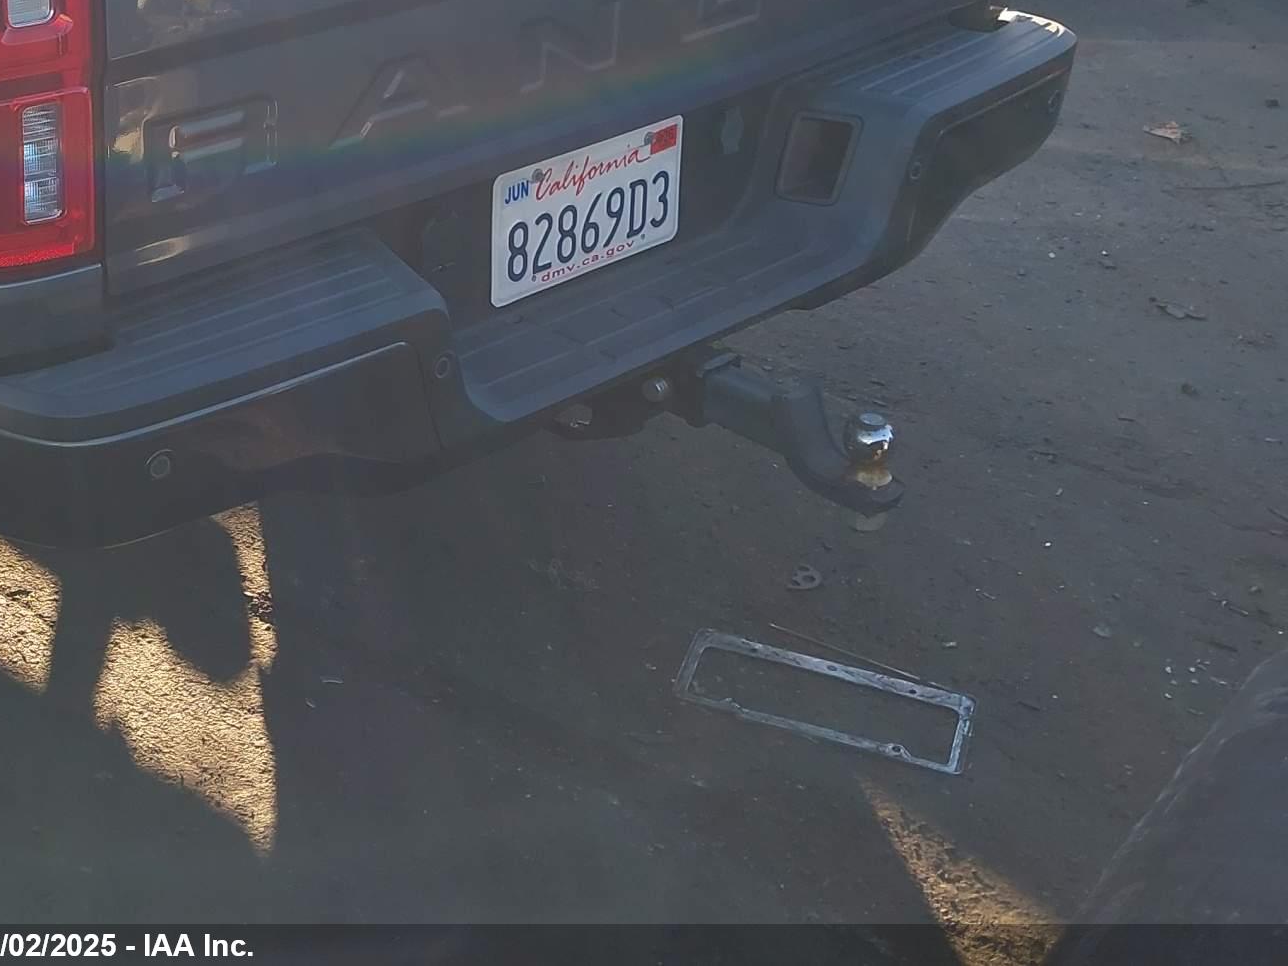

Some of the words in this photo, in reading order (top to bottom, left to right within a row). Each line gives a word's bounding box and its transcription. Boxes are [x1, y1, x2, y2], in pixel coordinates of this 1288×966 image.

[505, 181, 529, 204] JUN
[535, 148, 651, 201] California
[507, 170, 670, 282] 82869D3
[541, 239, 635, 283] dmv.ca.gov
